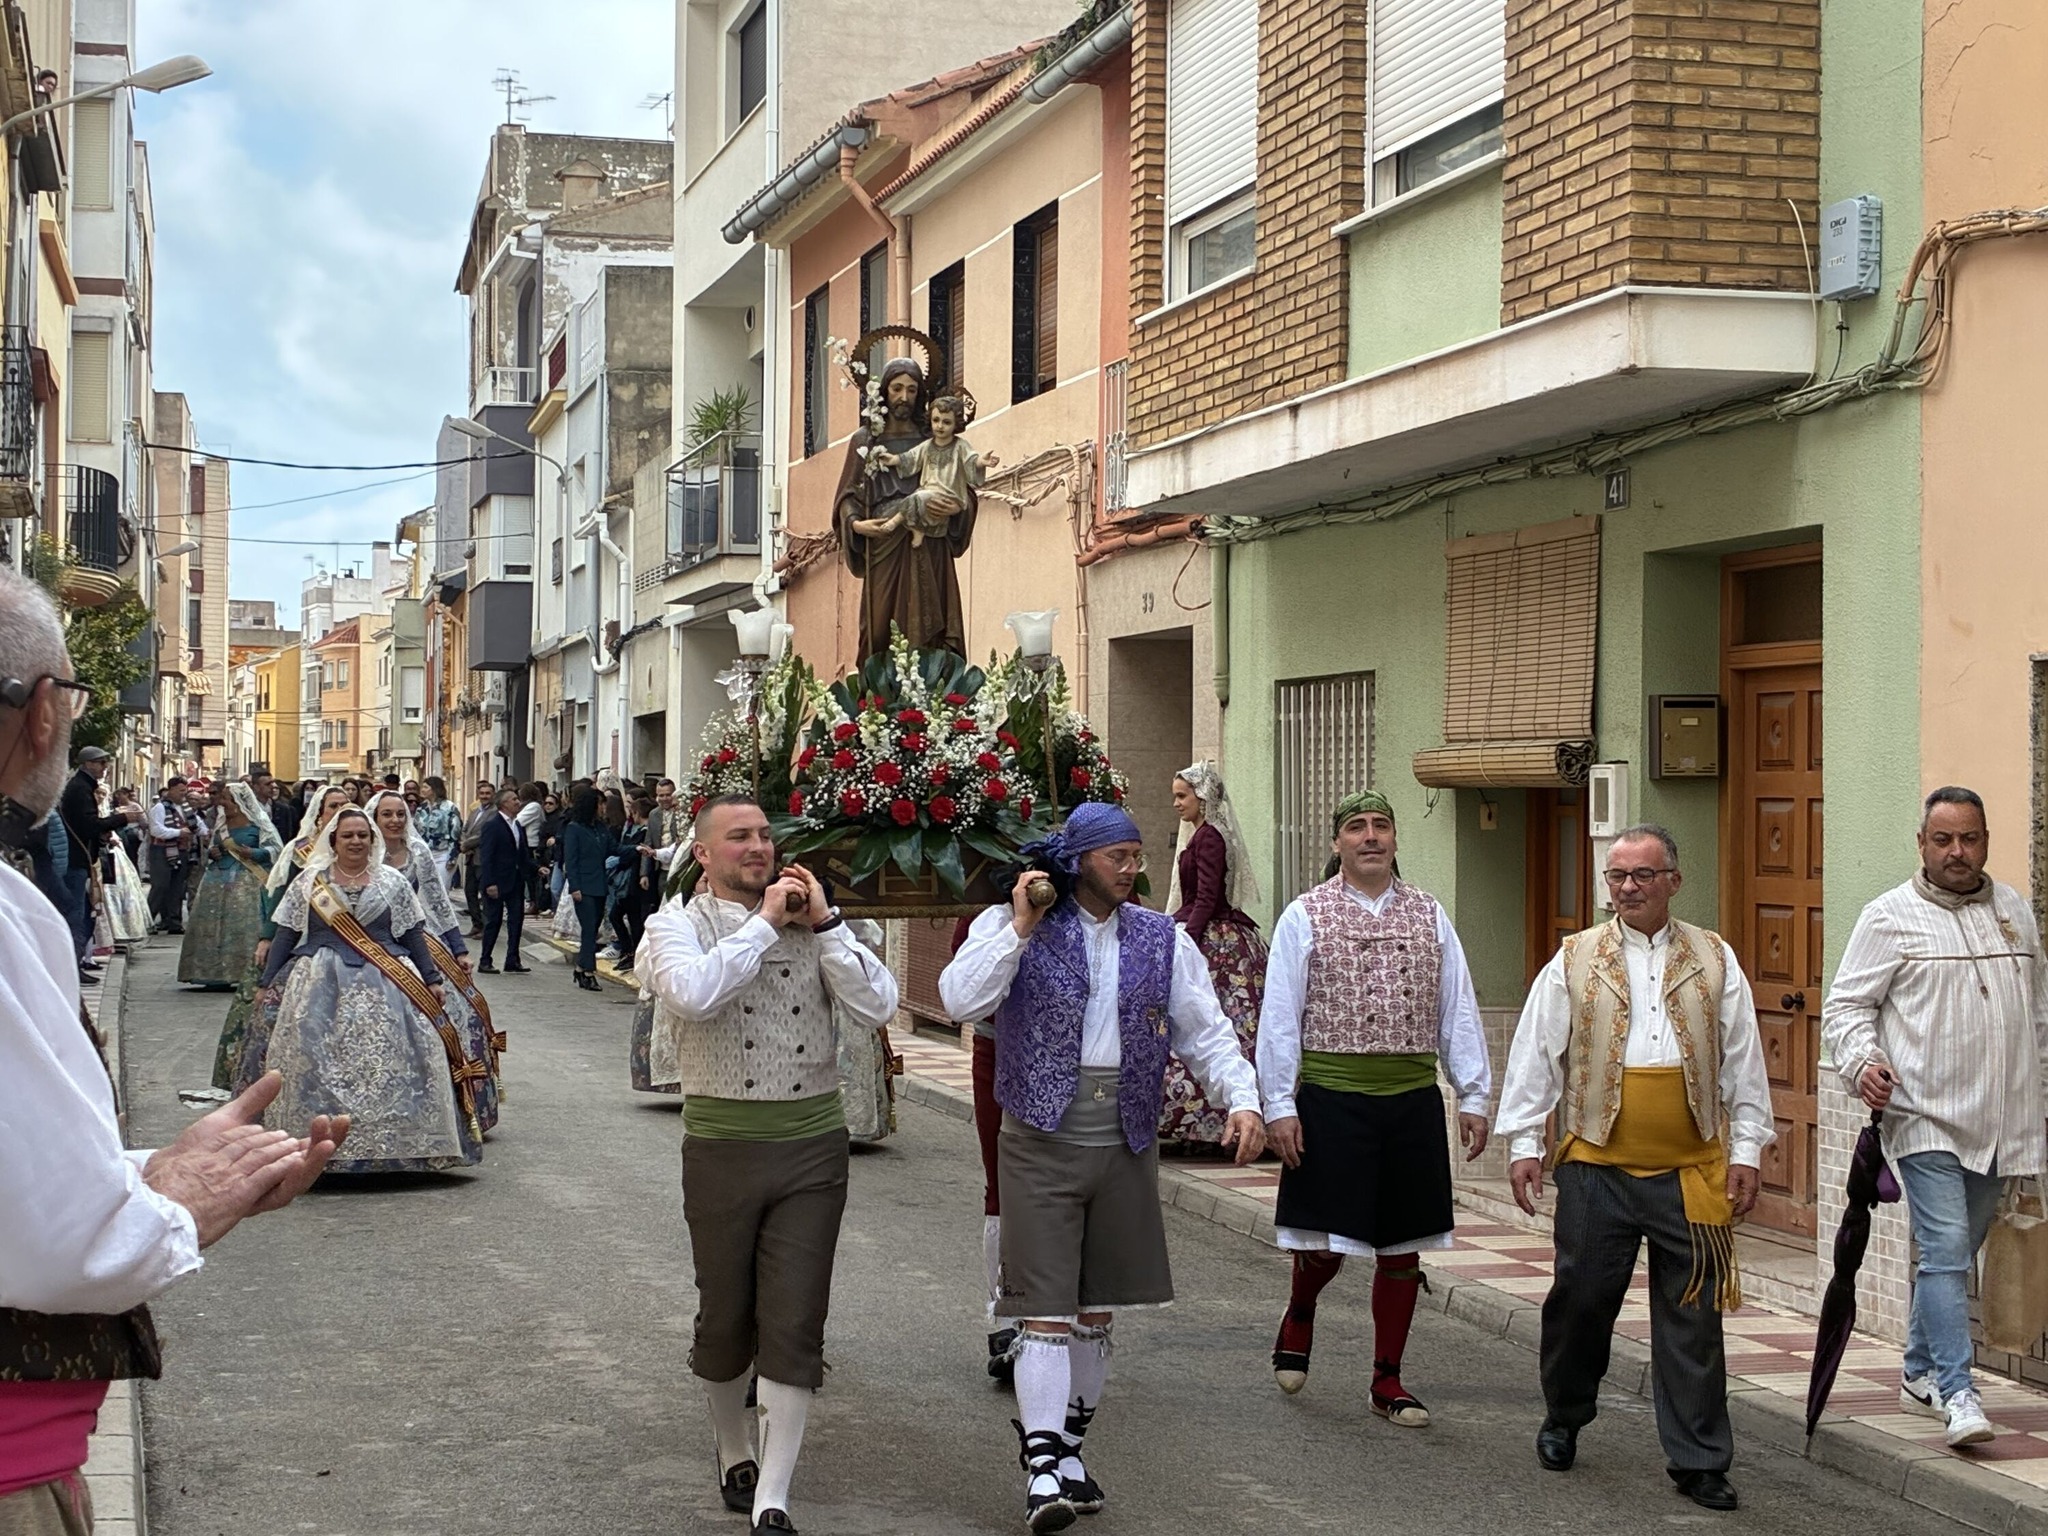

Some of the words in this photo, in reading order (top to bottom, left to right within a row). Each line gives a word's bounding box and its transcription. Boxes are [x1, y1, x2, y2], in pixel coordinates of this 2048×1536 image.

[1830, 217, 1847, 229] DIGI
[1609, 475, 1623, 504] 41
[1142, 592, 1154, 614] 39
